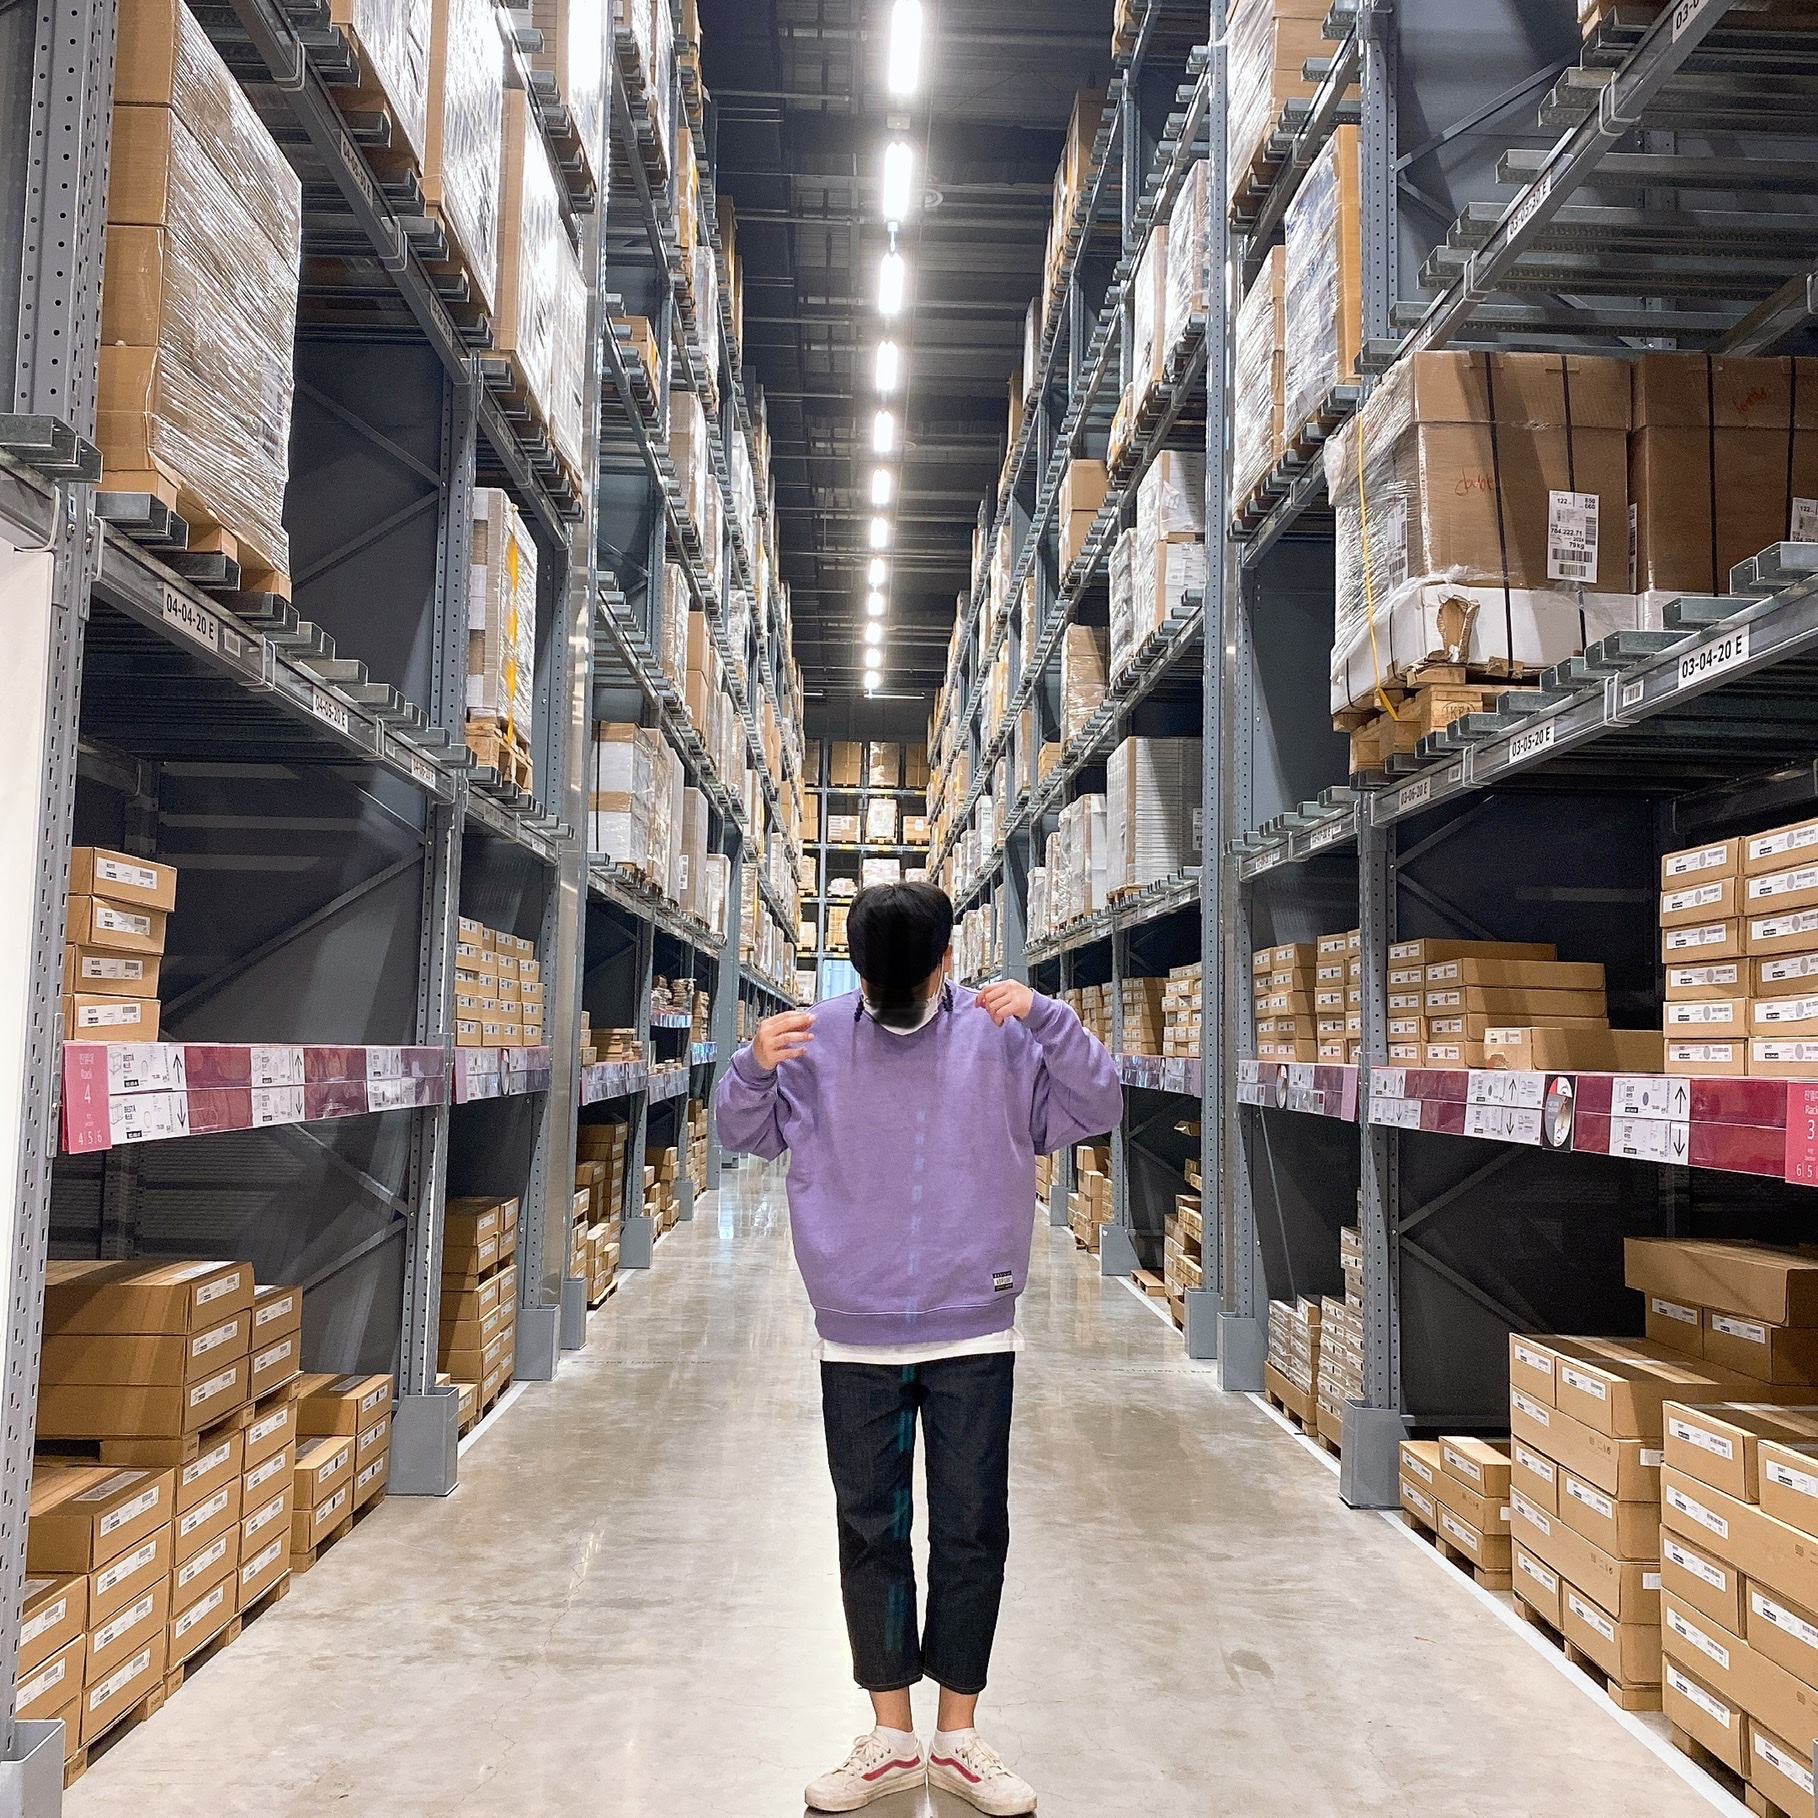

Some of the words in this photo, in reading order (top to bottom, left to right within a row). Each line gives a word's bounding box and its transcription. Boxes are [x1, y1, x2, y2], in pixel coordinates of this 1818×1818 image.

[1542, 182, 1546, 195] E
[166, 593, 207, 635] 04-04-20
[208, 621, 214, 640] E
[1682, 639, 1732, 678] 03-04-20
[1735, 634, 1742, 655] E
[314, 694, 342, 724] 04-05-20
[342, 713, 346, 726] E
[1512, 733, 1544, 757] 03-05-20
[1545, 726, 1550, 741] E
[1401, 783, 1423, 805] 03-06-20
[84, 1084, 91, 1104] 4
[1807, 1119, 1815, 1140] 3
